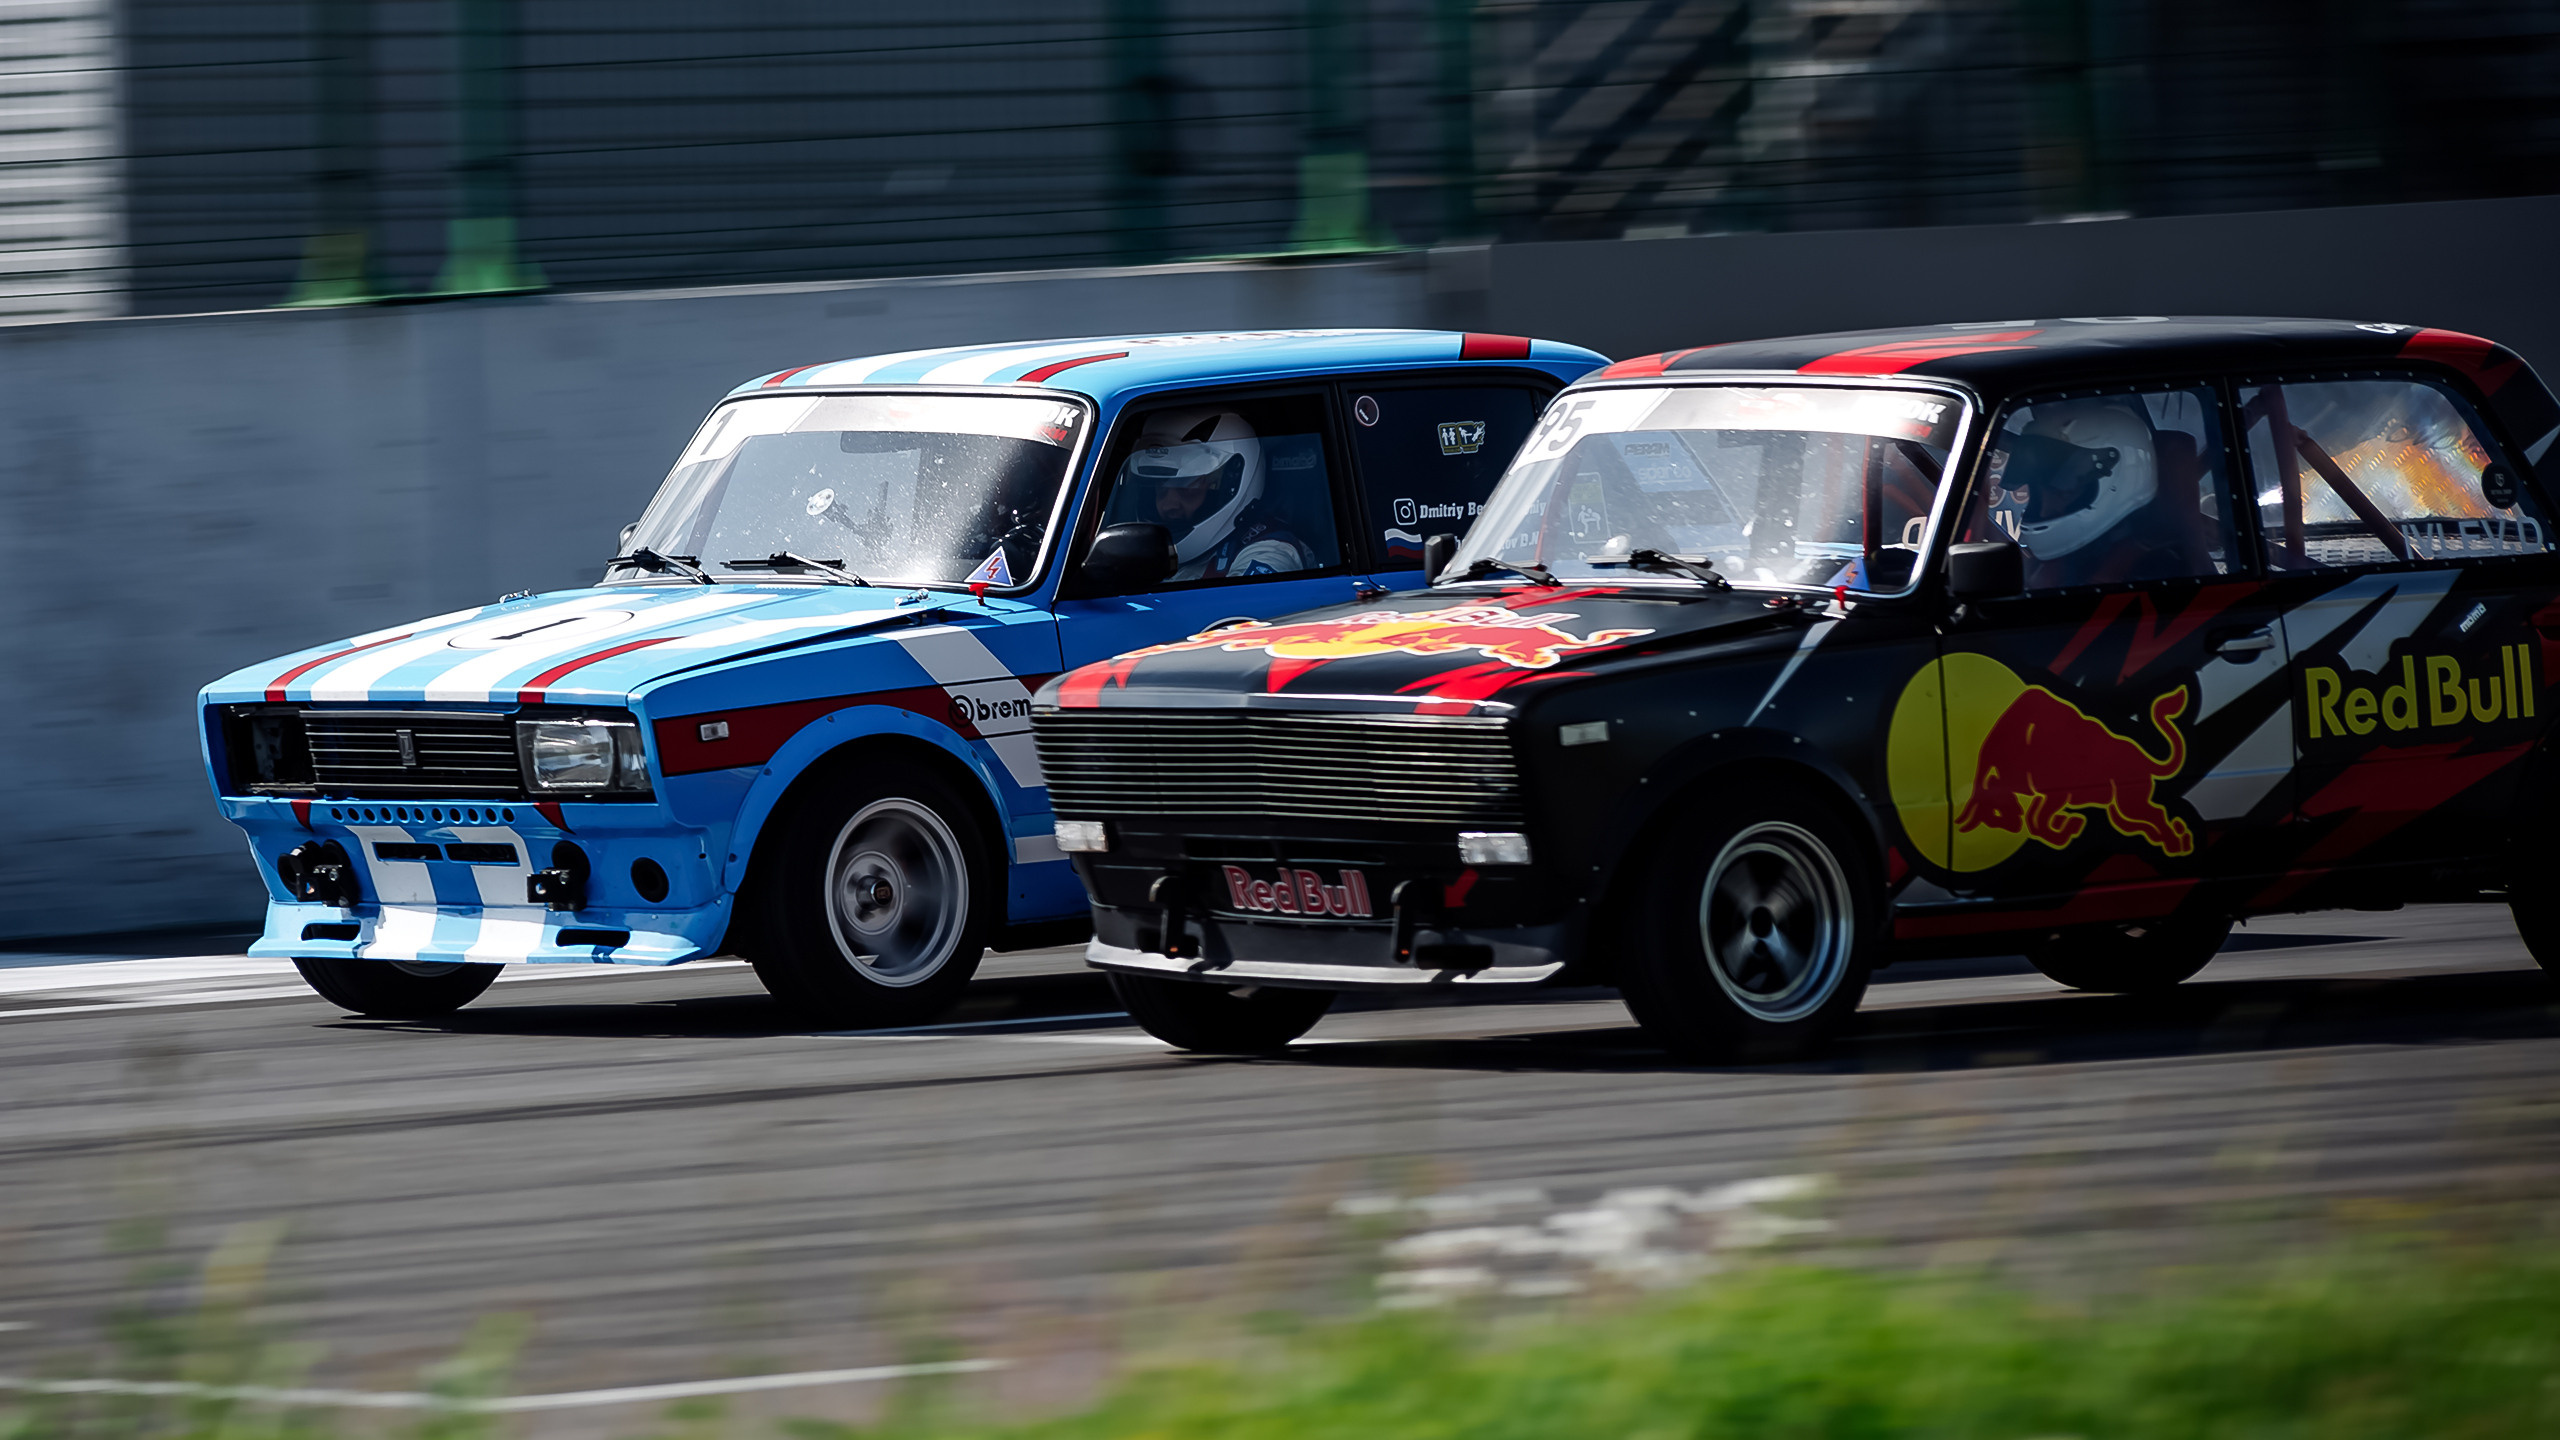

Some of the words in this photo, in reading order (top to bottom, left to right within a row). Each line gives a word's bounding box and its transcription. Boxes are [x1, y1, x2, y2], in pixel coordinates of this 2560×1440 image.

[700, 408, 738, 456] 1
[1528, 400, 1597, 452] 95
[1419, 501, 1464, 521] Dmitriy
[2305, 655, 2419, 739] Red
[2426, 644, 2535, 727] Bull
[1221, 865, 1301, 913] Red
[1292, 869, 1374, 918] Bull
